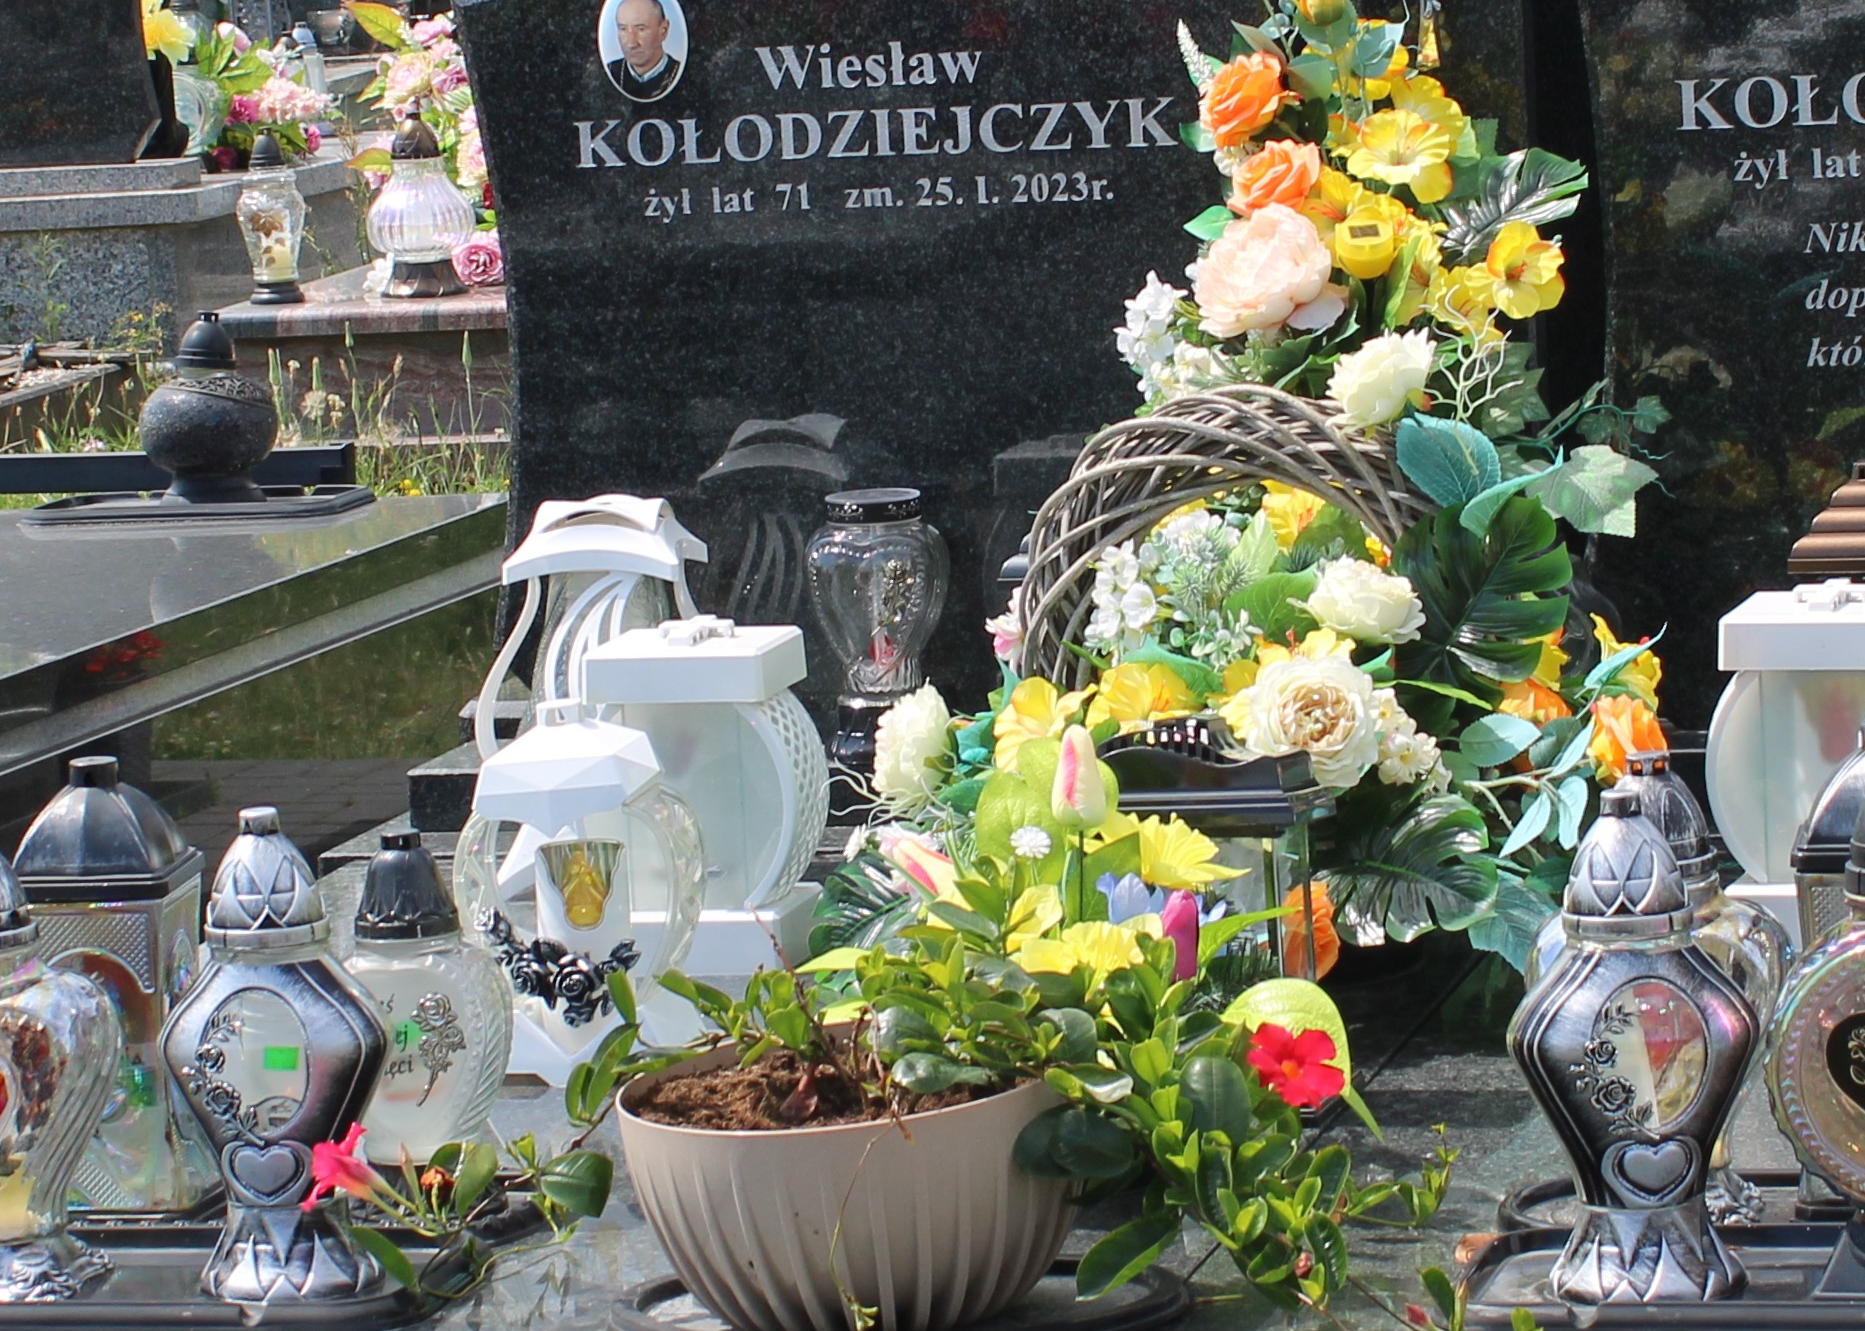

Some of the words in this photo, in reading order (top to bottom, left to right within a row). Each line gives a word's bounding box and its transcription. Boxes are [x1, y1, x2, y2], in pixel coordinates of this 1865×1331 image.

[755, 41, 981, 89] Wiesław
[574, 96, 1178, 168] KOŁODZIEJCZYK
[1735, 150, 1788, 186] żył
[1813, 148, 1861, 178] lat
[645, 188, 691, 223] żył
[712, 187, 753, 213] lat
[776, 182, 810, 210] 71
[845, 188, 903, 208] zm.
[917, 177, 963, 206] 25.
[1012, 172, 1113, 202] 2023r.
